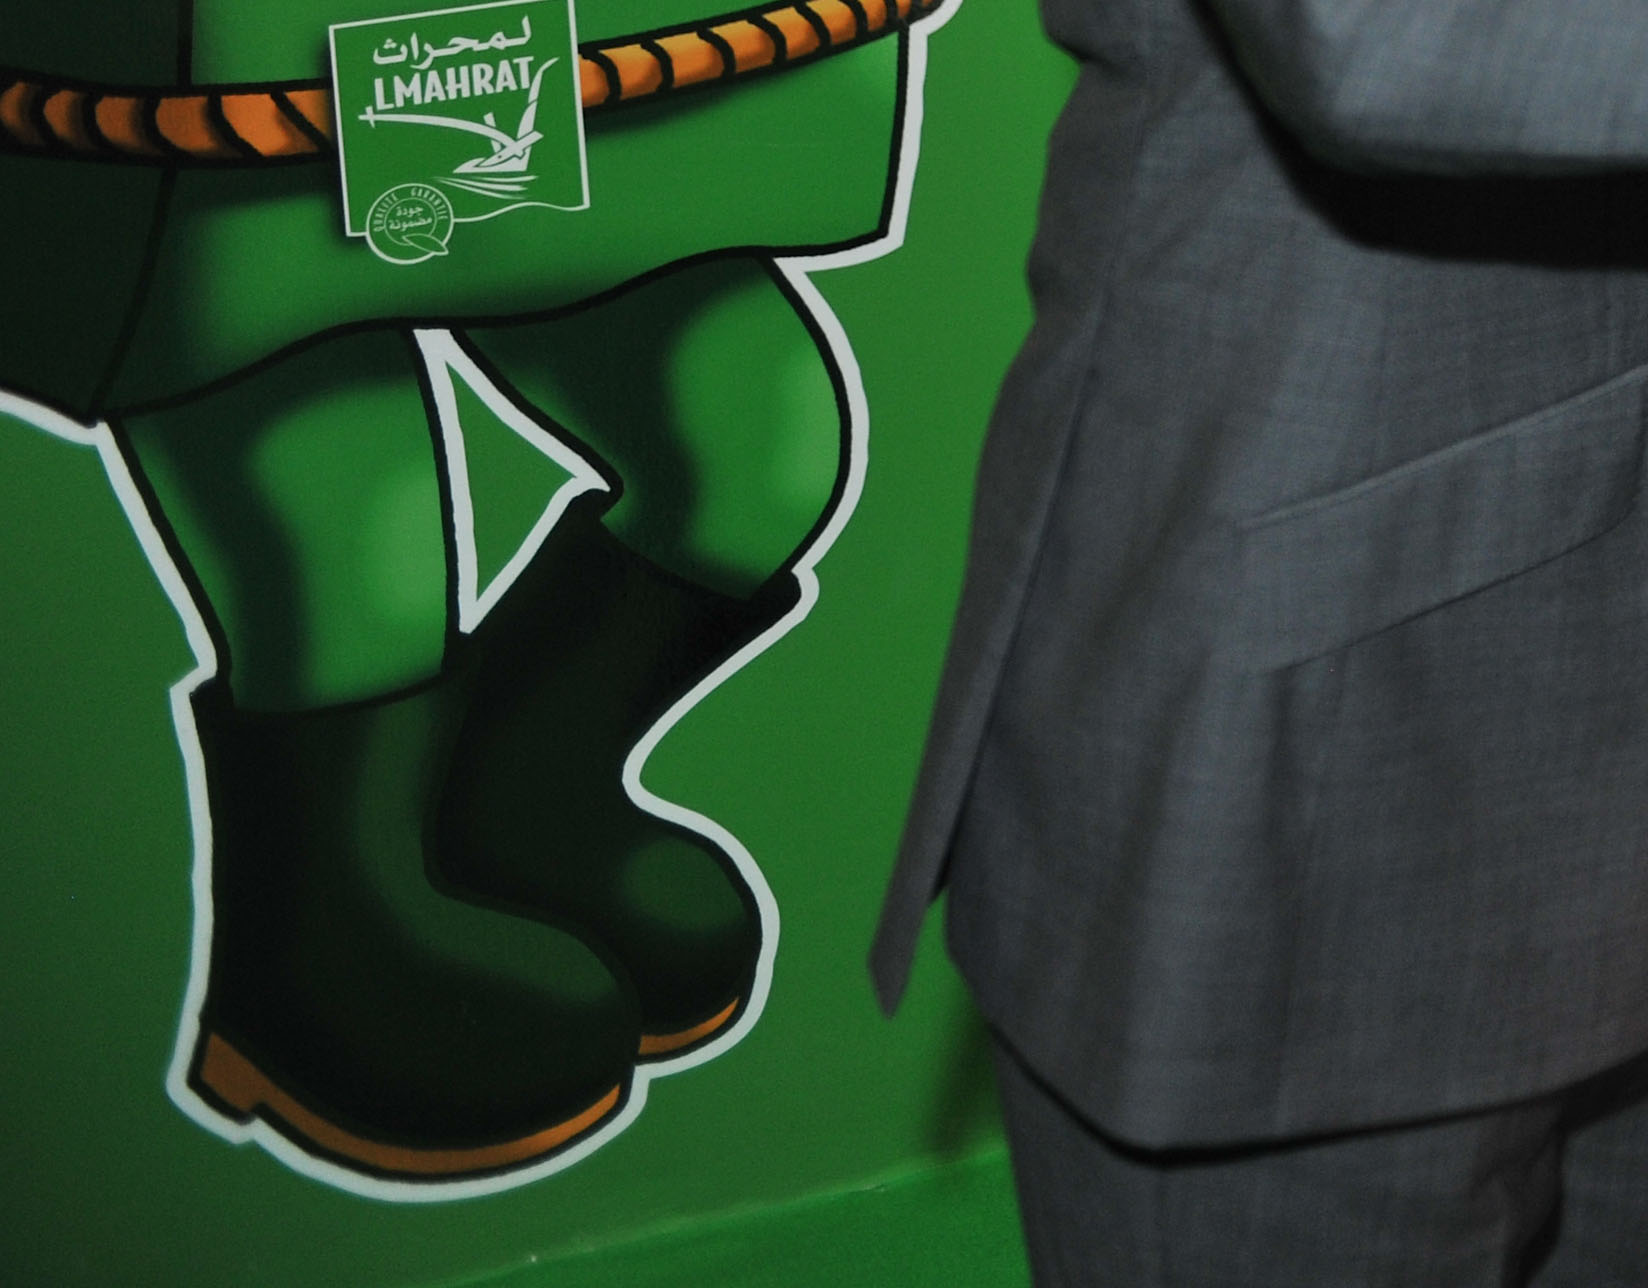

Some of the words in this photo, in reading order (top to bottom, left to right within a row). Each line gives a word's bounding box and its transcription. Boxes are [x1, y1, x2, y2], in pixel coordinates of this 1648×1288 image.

[373, 14, 532, 70] لمحراث
[373, 56, 534, 111] LMAHRAT
[395, 205, 424, 217] جودة
